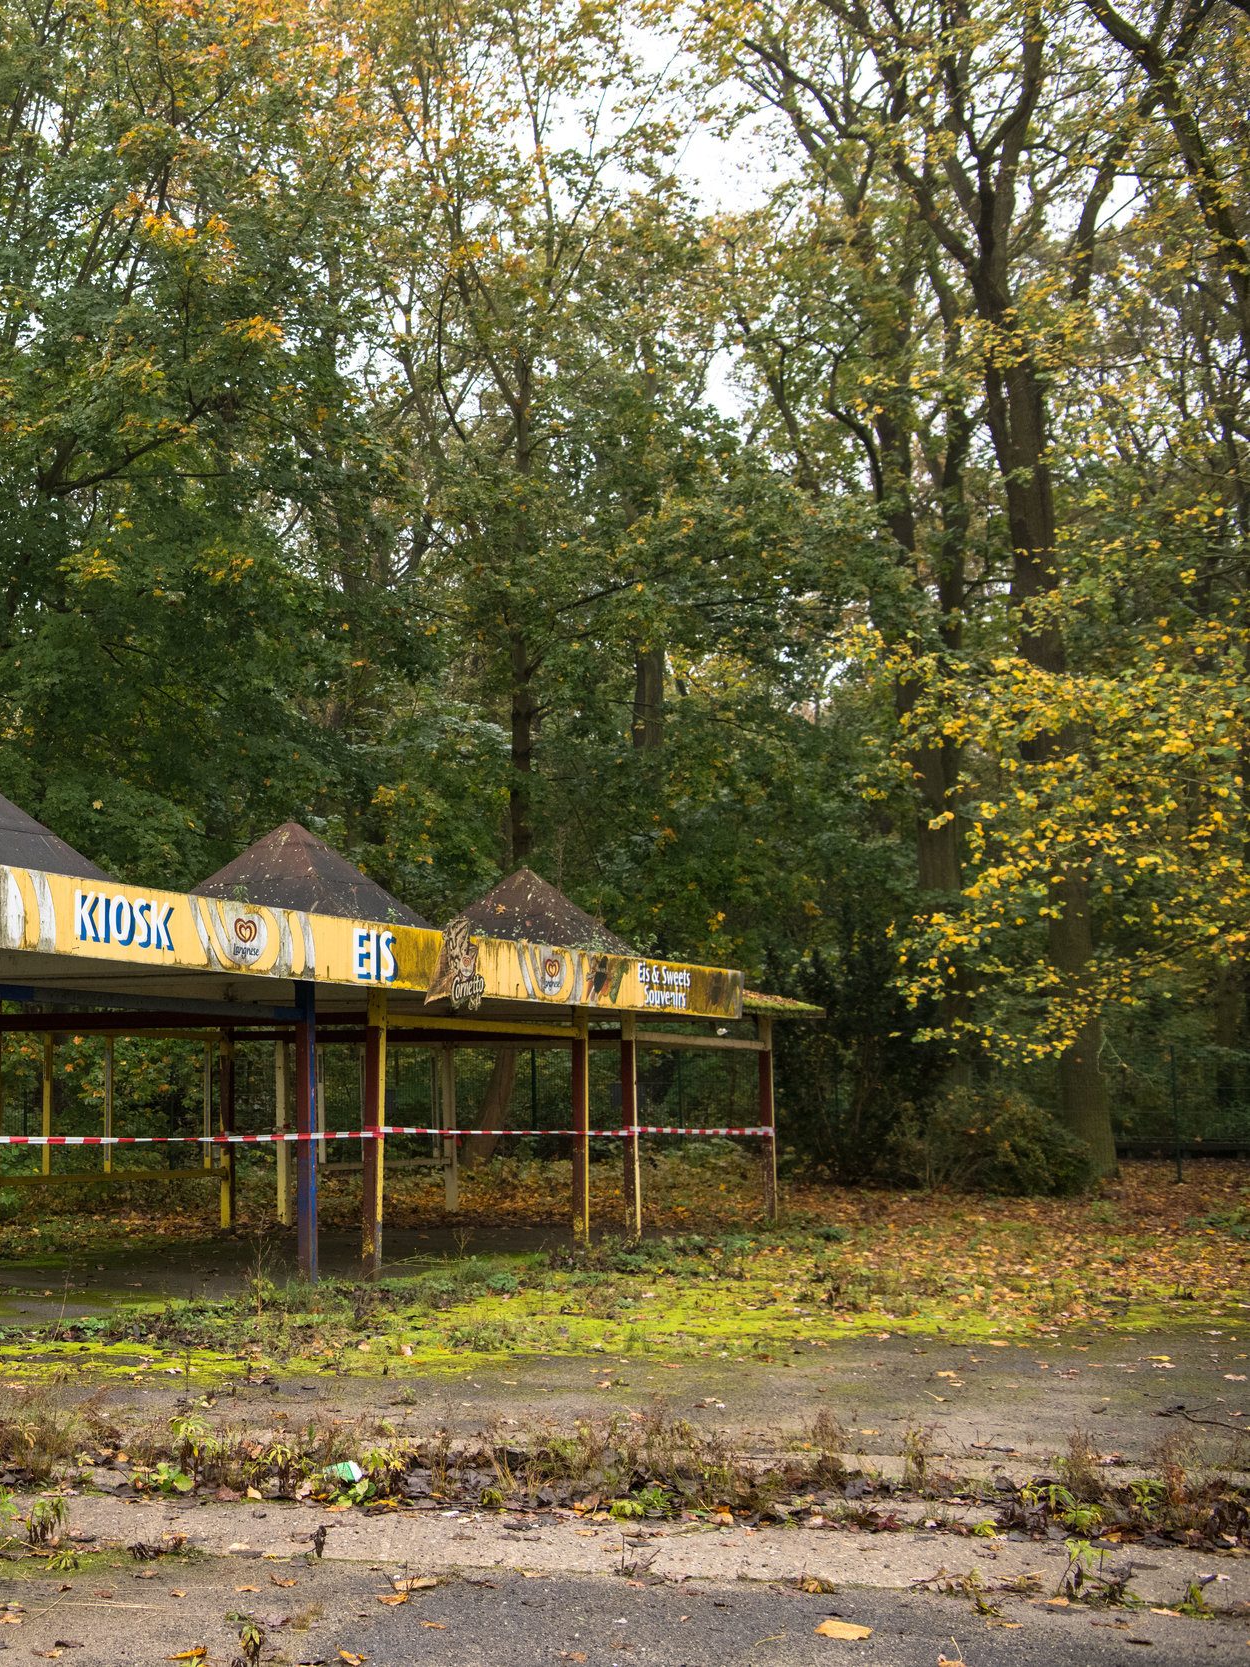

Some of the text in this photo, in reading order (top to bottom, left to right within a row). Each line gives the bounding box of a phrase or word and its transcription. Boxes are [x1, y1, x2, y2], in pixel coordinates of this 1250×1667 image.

[74, 889, 174, 951] KIOSK
[233, 943, 259, 959] Langnese
[353, 927, 398, 982] EIS
[452, 973, 485, 1003] Cornetto
[638, 961, 690, 987] Eis & Sweets
[644, 985, 686, 1010] Souvenirs
